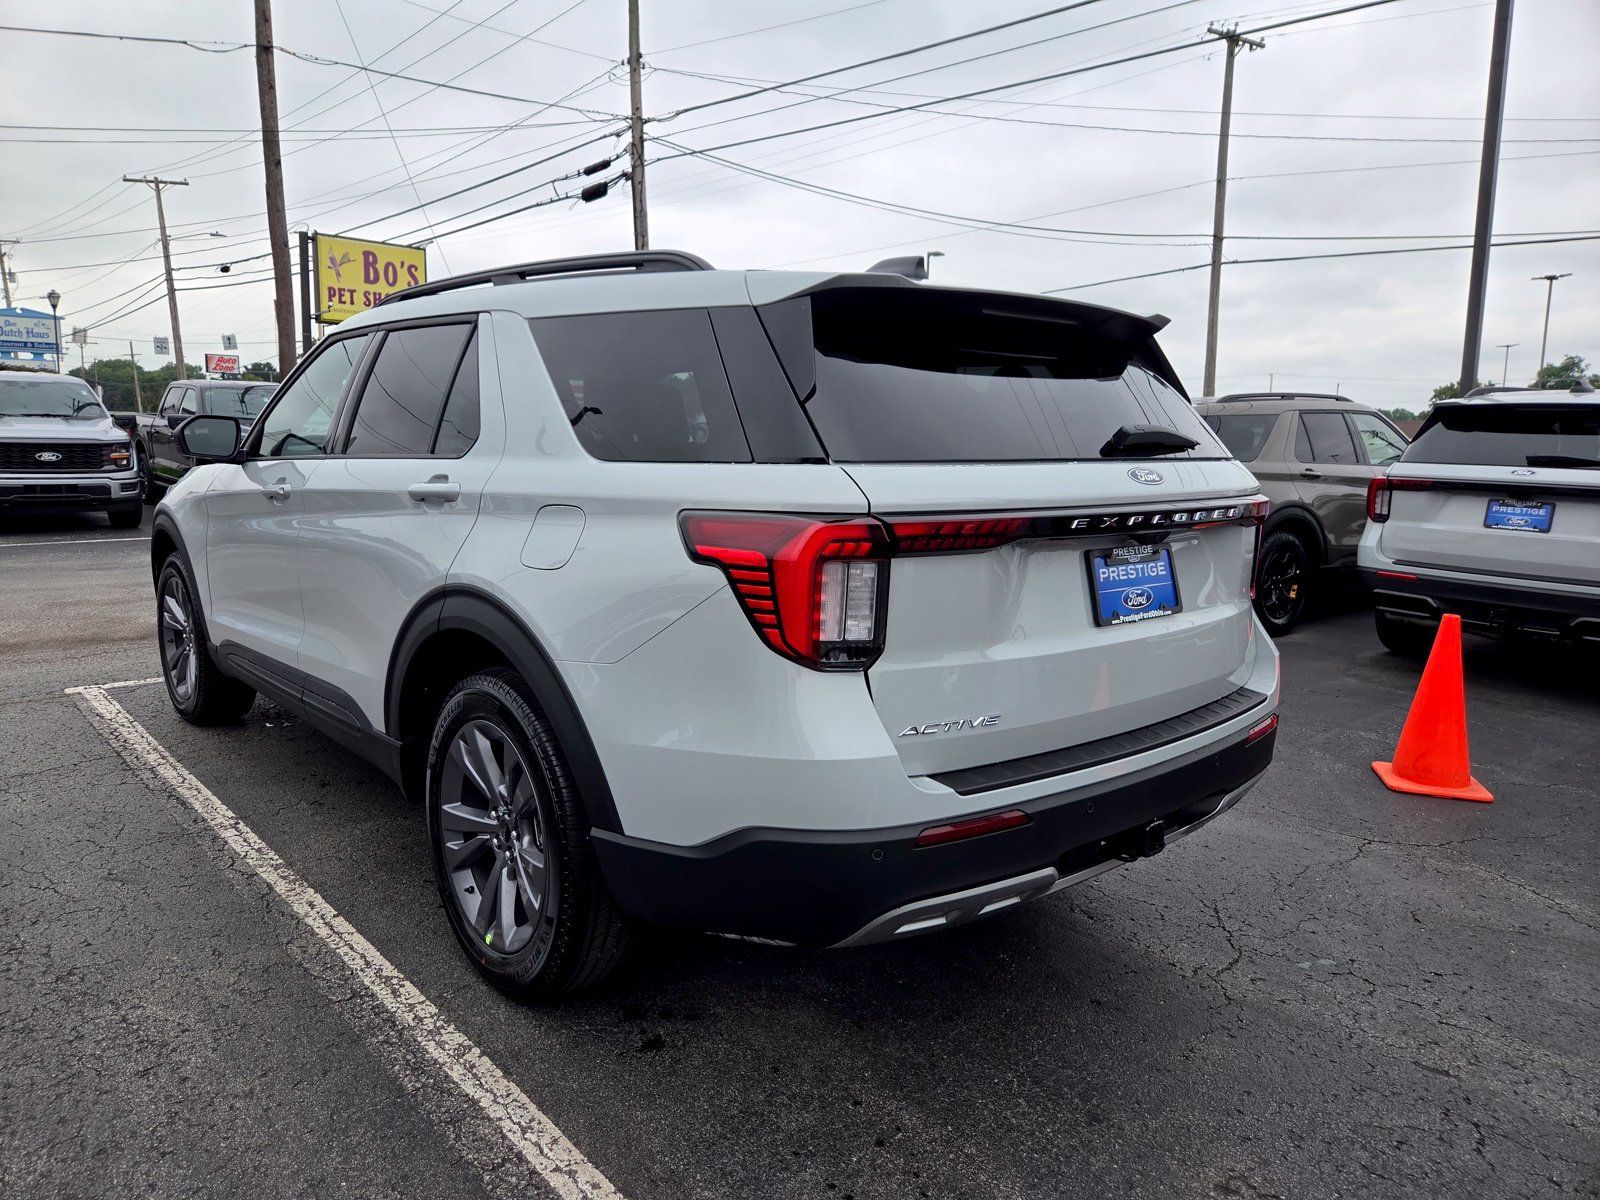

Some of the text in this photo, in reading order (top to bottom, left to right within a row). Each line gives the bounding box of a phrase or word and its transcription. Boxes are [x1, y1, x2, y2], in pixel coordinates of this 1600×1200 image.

[327, 286, 392, 307] PET SH
[24, 327, 49, 339] Haus
[216, 356, 237, 364] Auto
[212, 363, 235, 372] Zone
[1136, 470, 1160, 482] Ford
[1492, 505, 1546, 516] PRESTIGE
[1070, 506, 1243, 529] EXPLORER
[1113, 545, 1153, 556] PRESTIGE
[1100, 562, 1166, 582] PRESTIGE
[1127, 589, 1147, 606] Ford
[1112, 610, 1171, 624] www.PrestigeFordOhio.com
[898, 714, 1002, 737] ACTIVE
